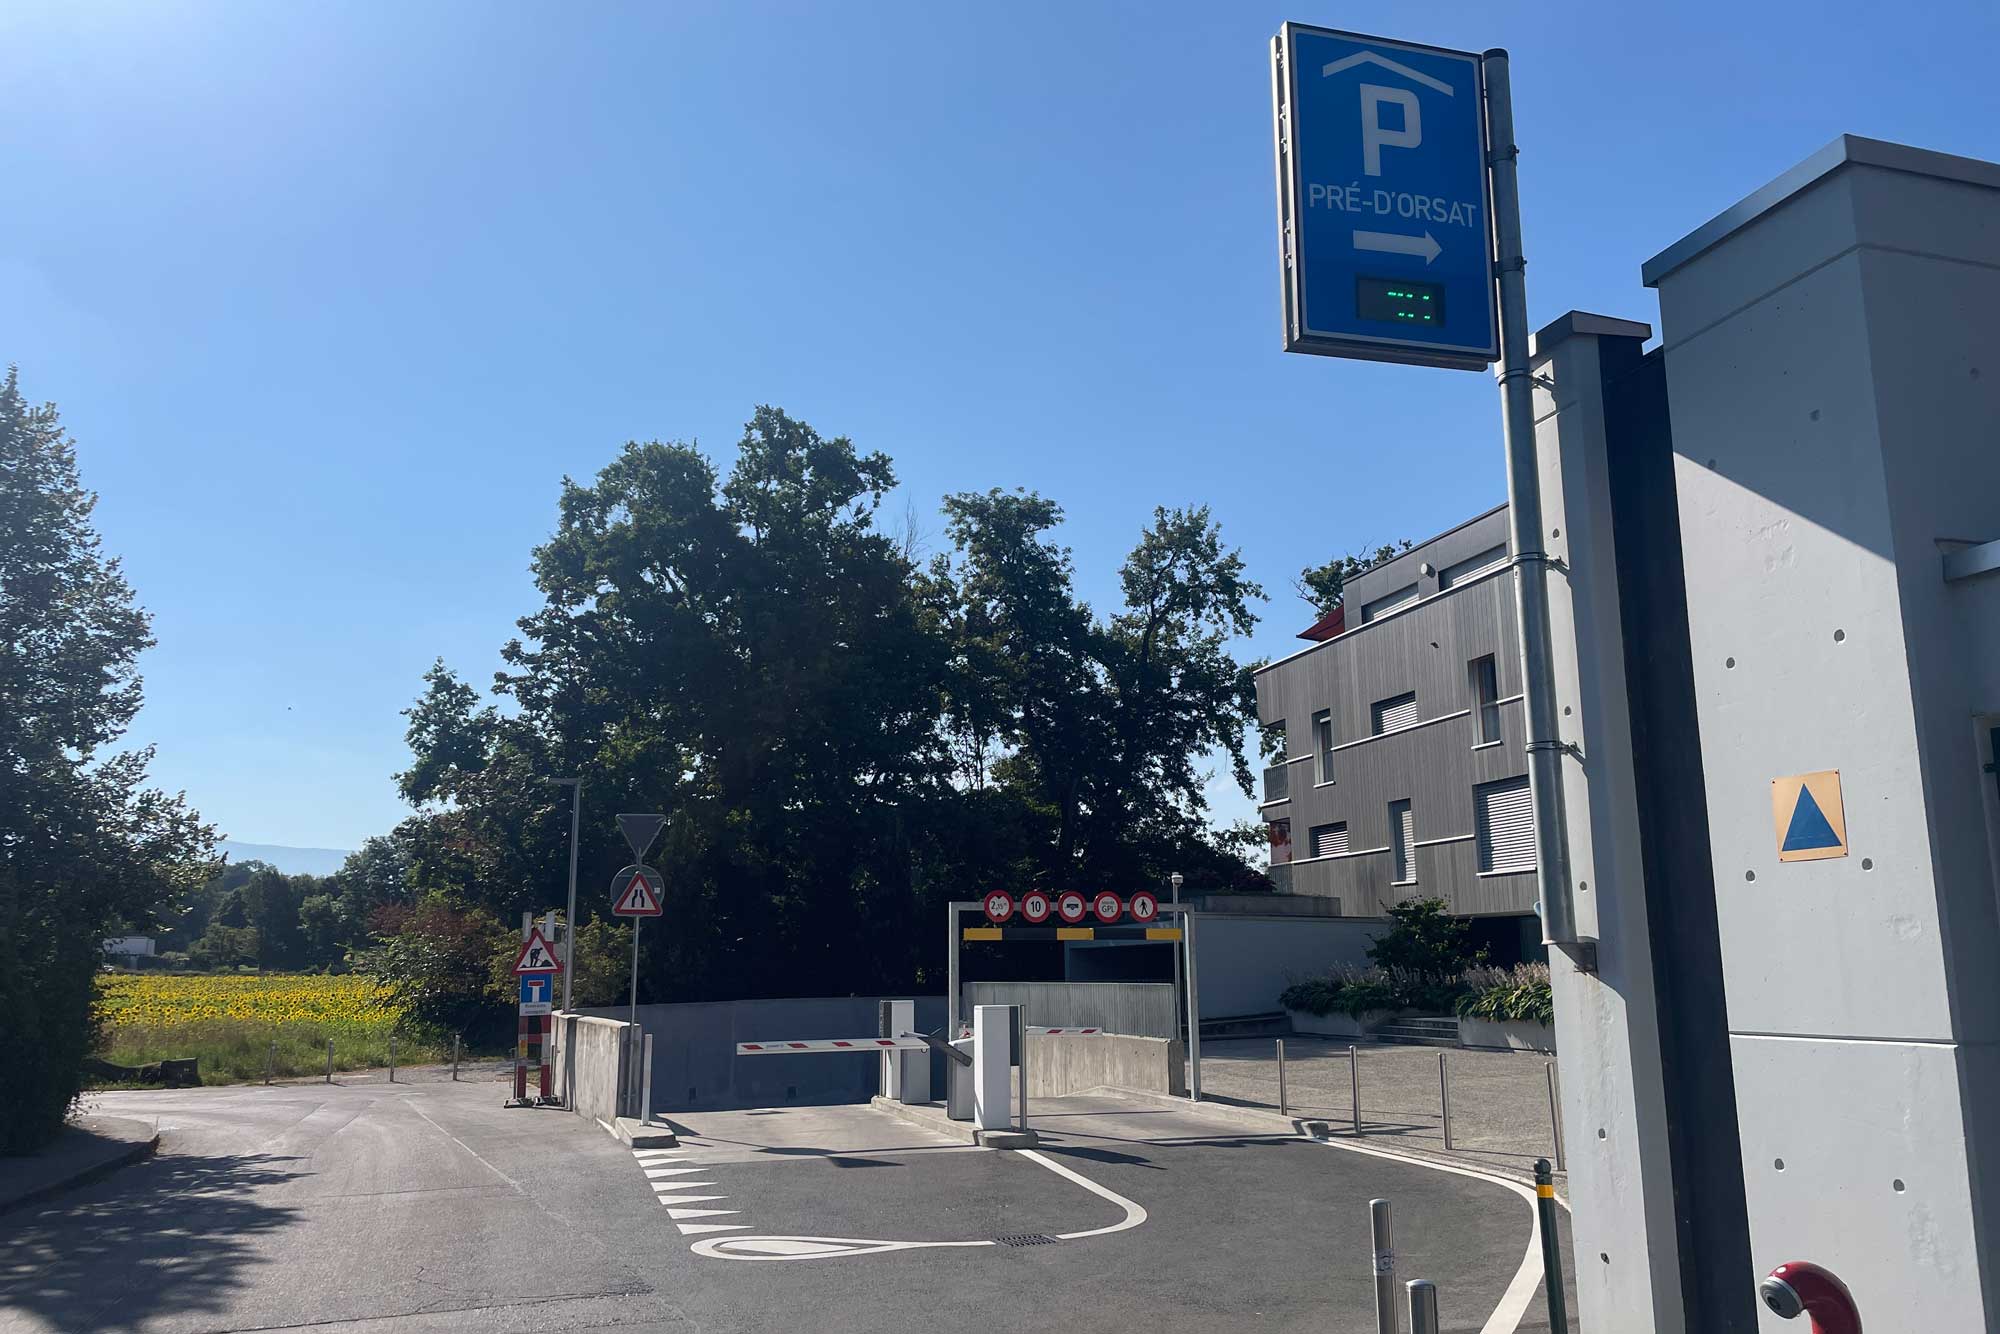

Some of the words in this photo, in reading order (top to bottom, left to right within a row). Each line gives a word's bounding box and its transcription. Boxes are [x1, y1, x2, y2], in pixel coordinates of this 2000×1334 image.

[1359, 83, 1422, 177] P
[1308, 181, 1477, 228] PRÉ-D'ORSAT
[1030, 900, 1041, 913] 10
